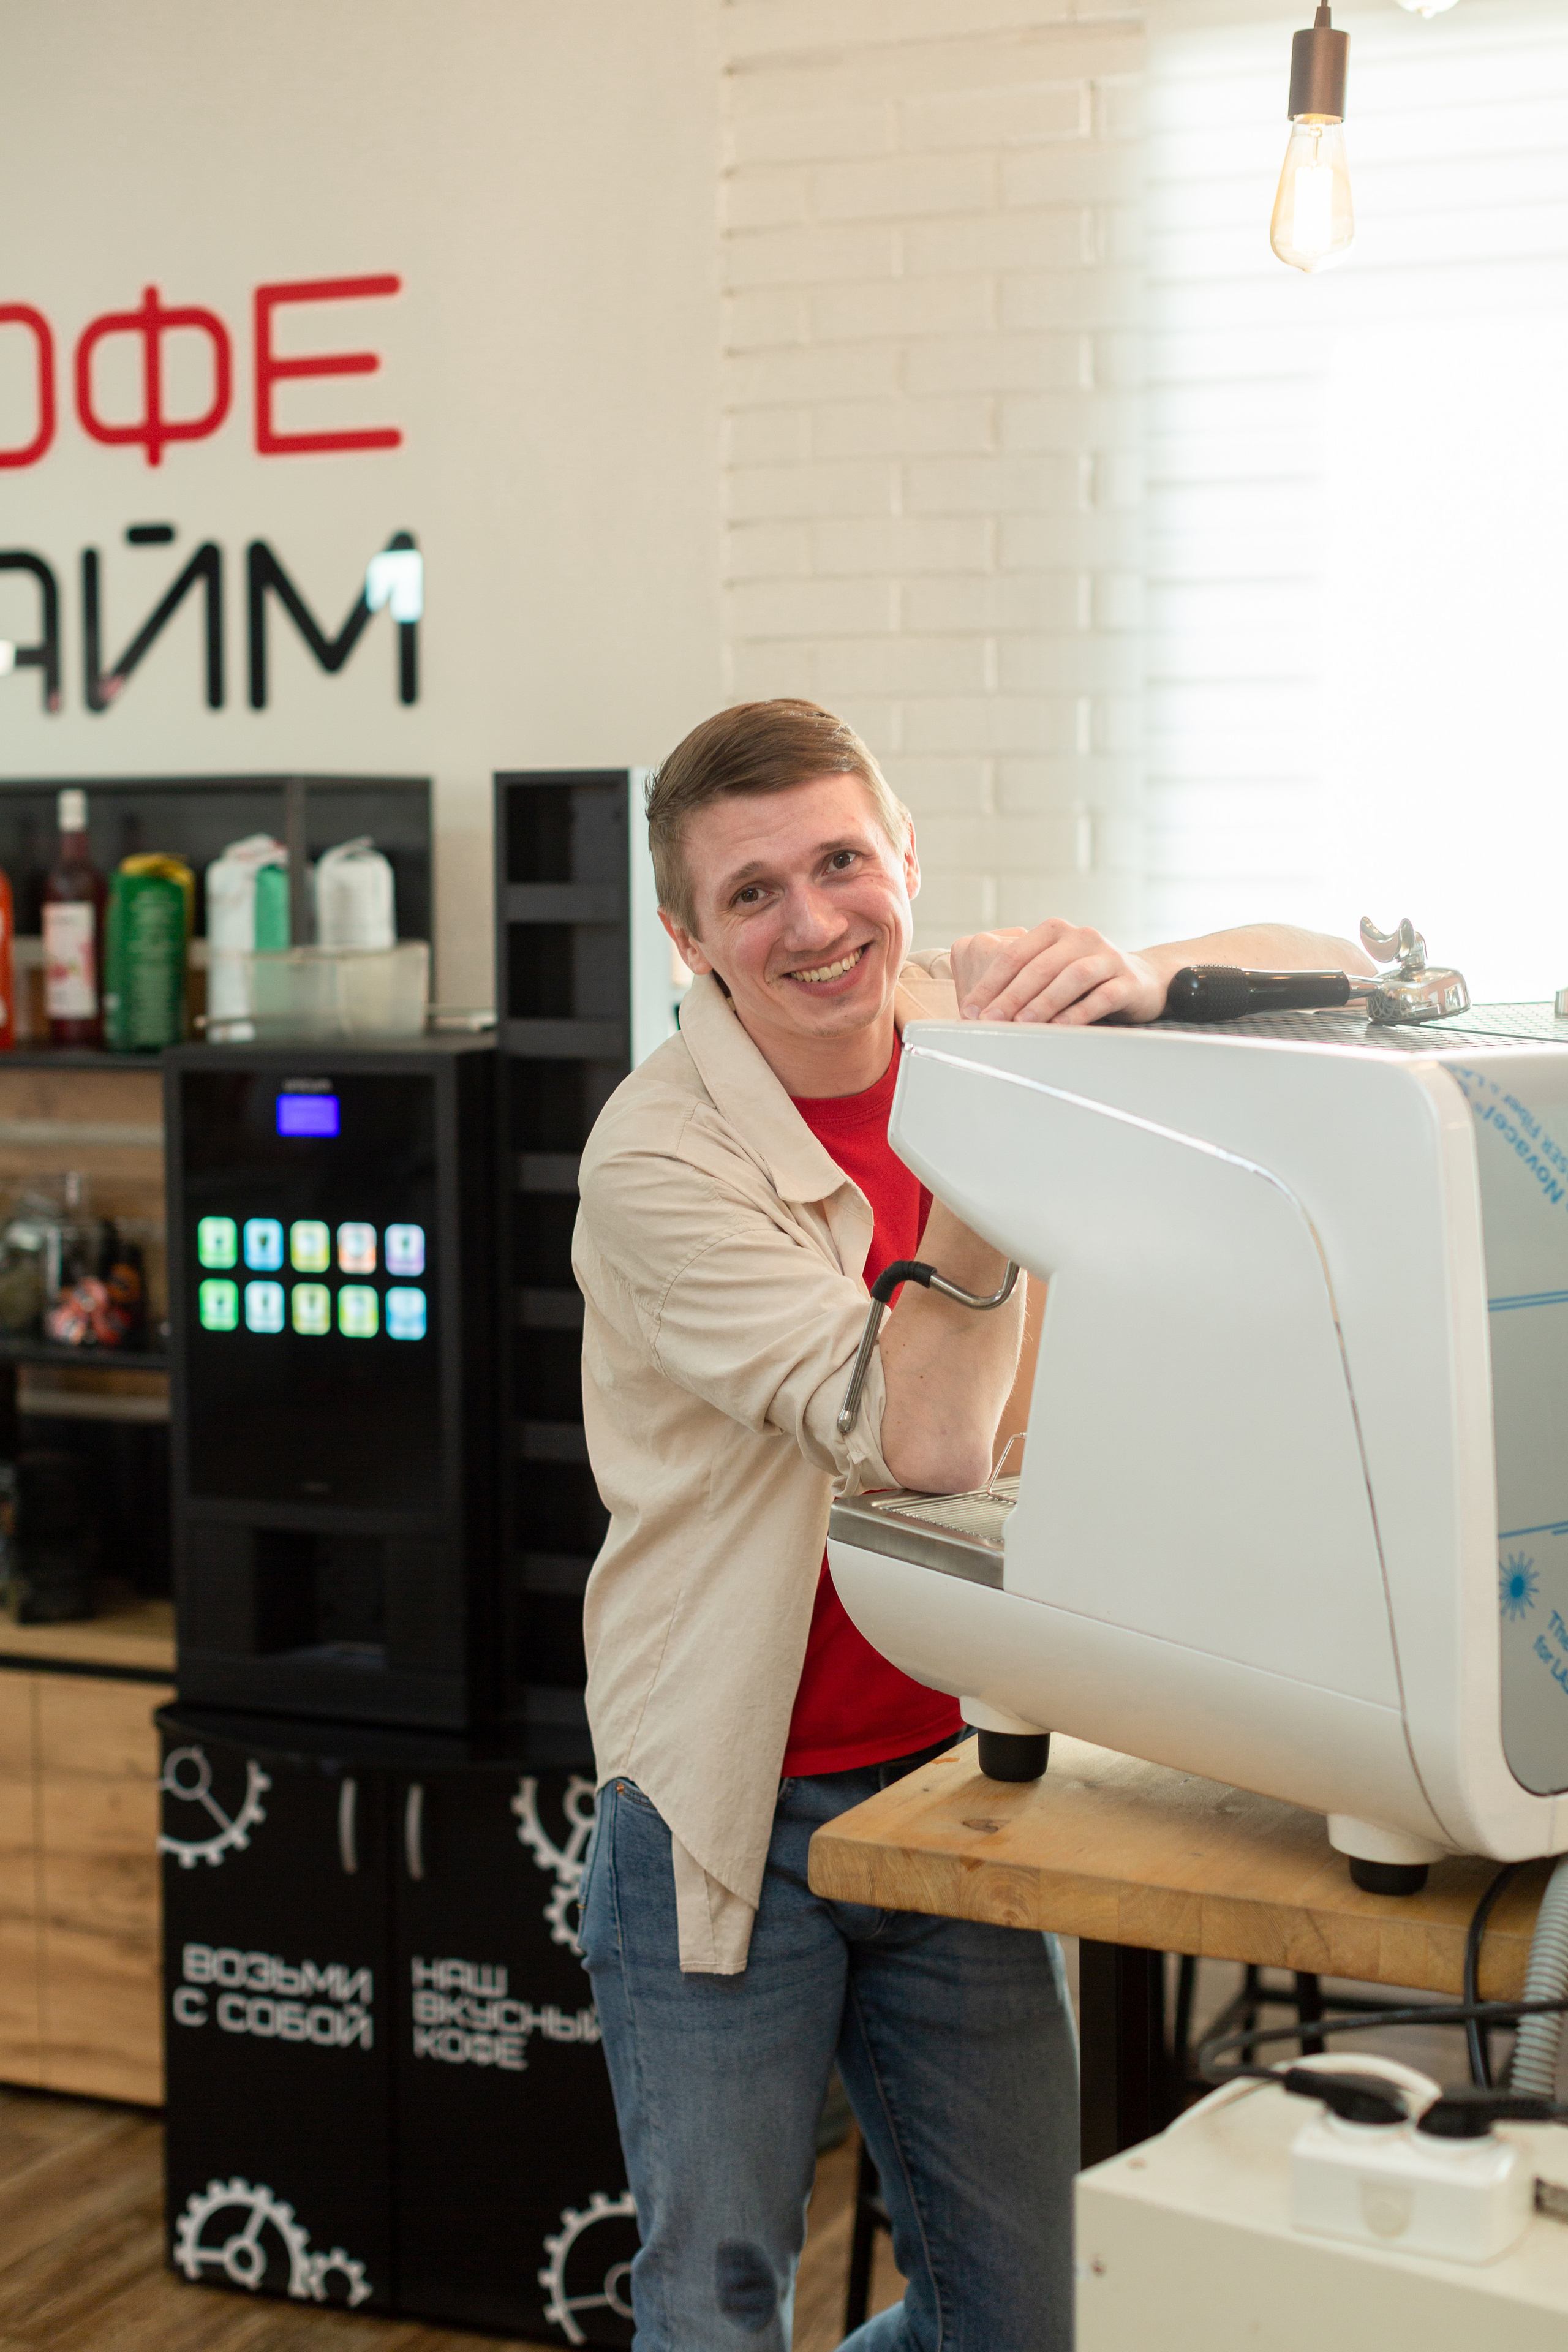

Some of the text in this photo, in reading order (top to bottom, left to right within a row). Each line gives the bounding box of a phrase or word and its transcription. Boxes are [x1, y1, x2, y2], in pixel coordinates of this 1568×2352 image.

[183, 1942, 373, 2005] ВОЗЬМИ
[412, 1956, 508, 1999] НАШ
[173, 1985, 373, 2051] С СОБОЙ
[413, 2024, 529, 2071] КОФЕ
